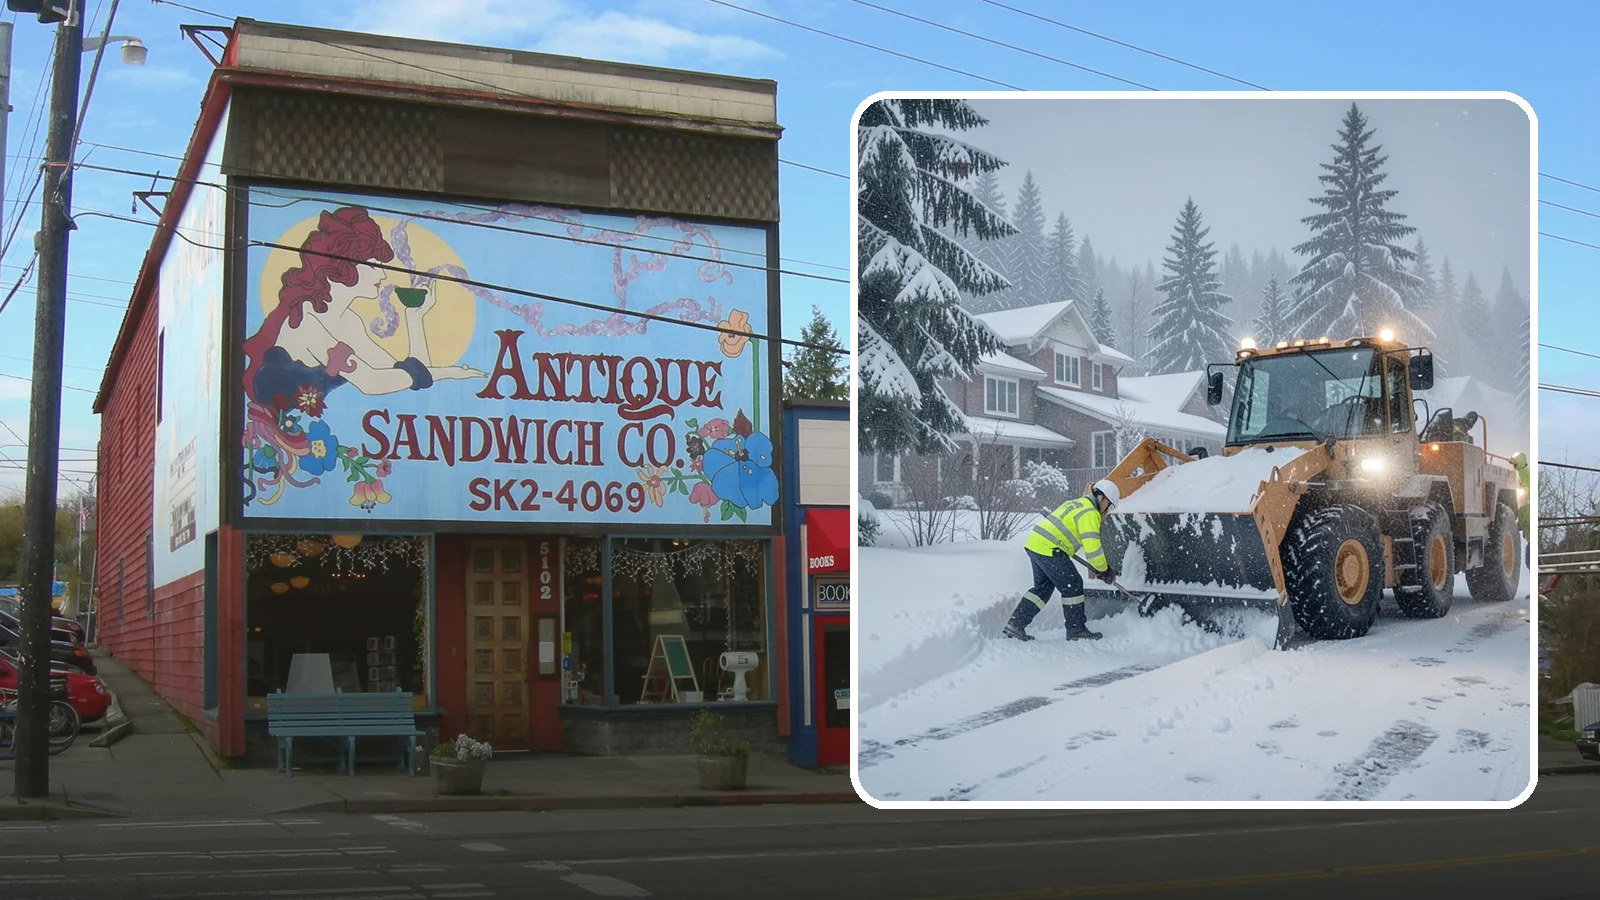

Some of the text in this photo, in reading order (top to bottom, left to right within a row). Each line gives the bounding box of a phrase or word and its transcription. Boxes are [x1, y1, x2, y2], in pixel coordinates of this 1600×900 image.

[476, 329, 723, 421] ANTIQUE
[361, 408, 686, 469] SANDWICH CO.
[468, 477, 646, 513] SK2-4069
[540, 541, 551, 599] 5102
[809, 555, 835, 569] BOOKS
